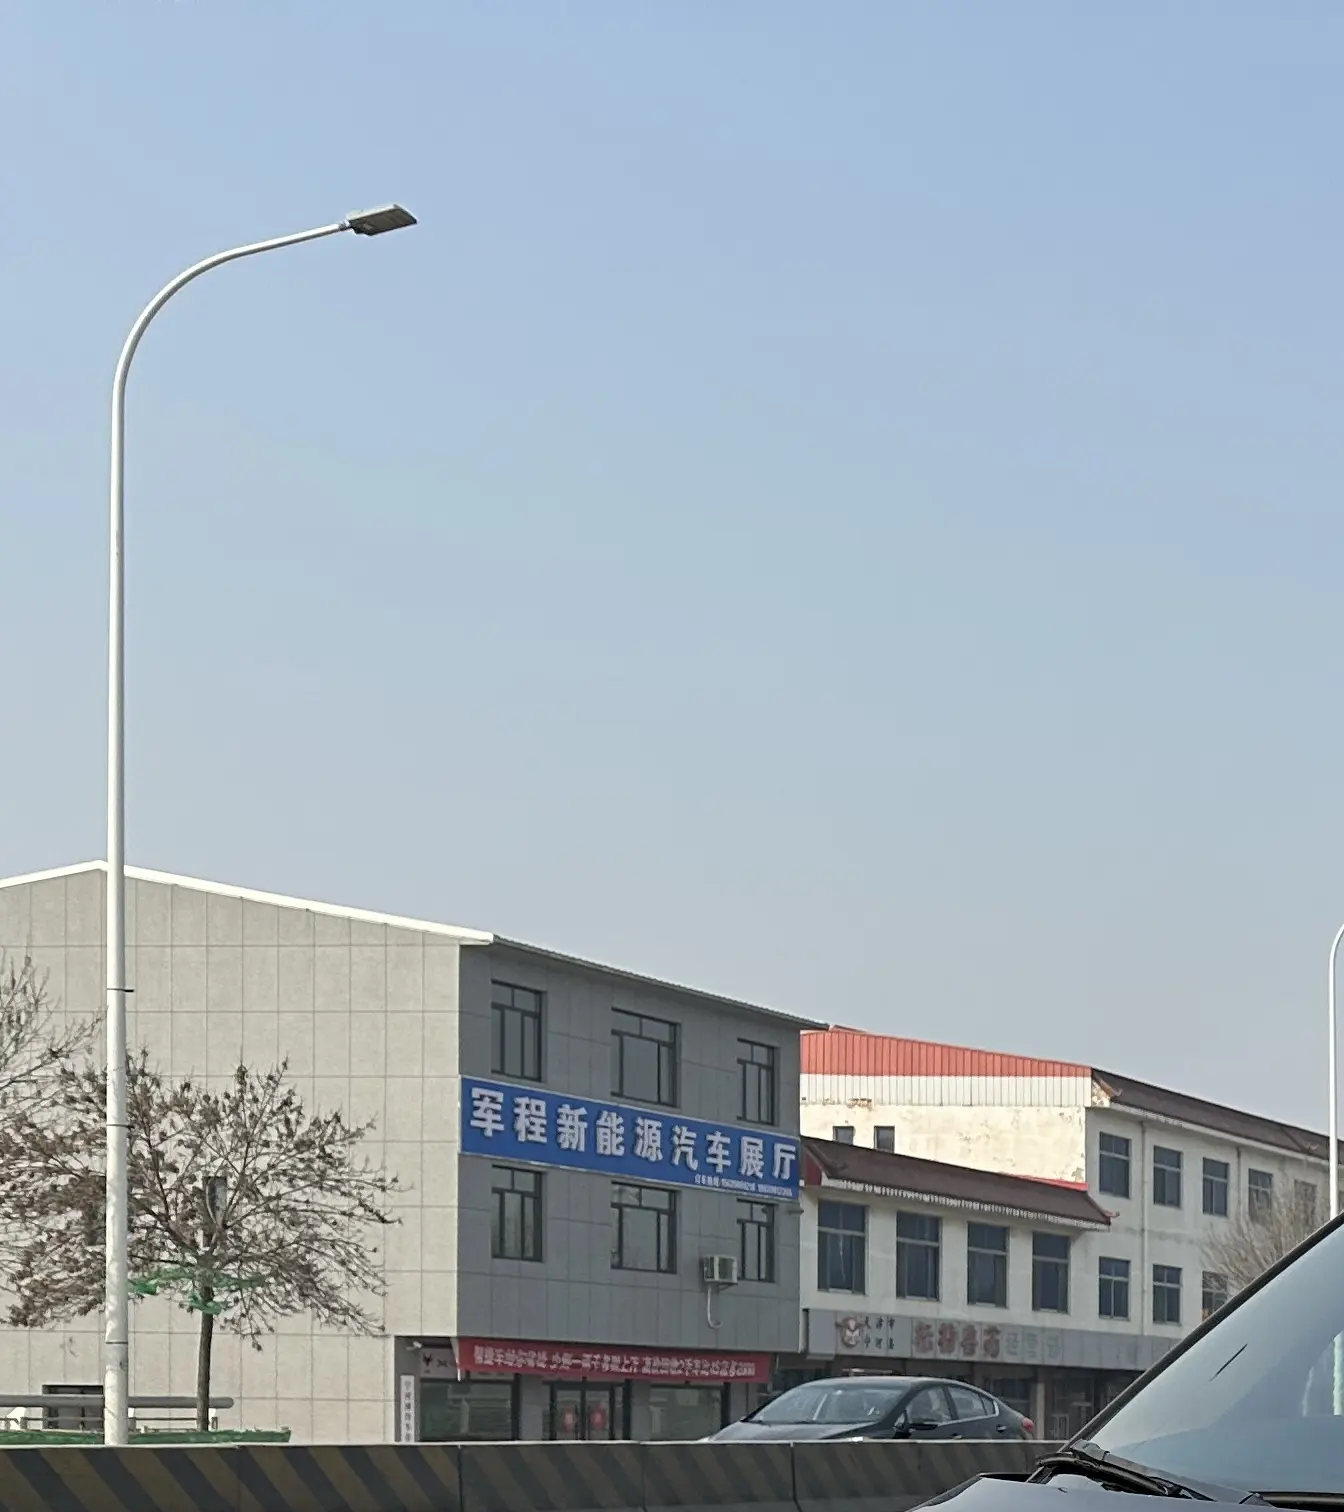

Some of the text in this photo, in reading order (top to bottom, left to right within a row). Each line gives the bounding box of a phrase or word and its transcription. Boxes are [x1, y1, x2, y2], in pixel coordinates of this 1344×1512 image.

[469, 1086, 797, 1181] 军程新能源汽车展厅
